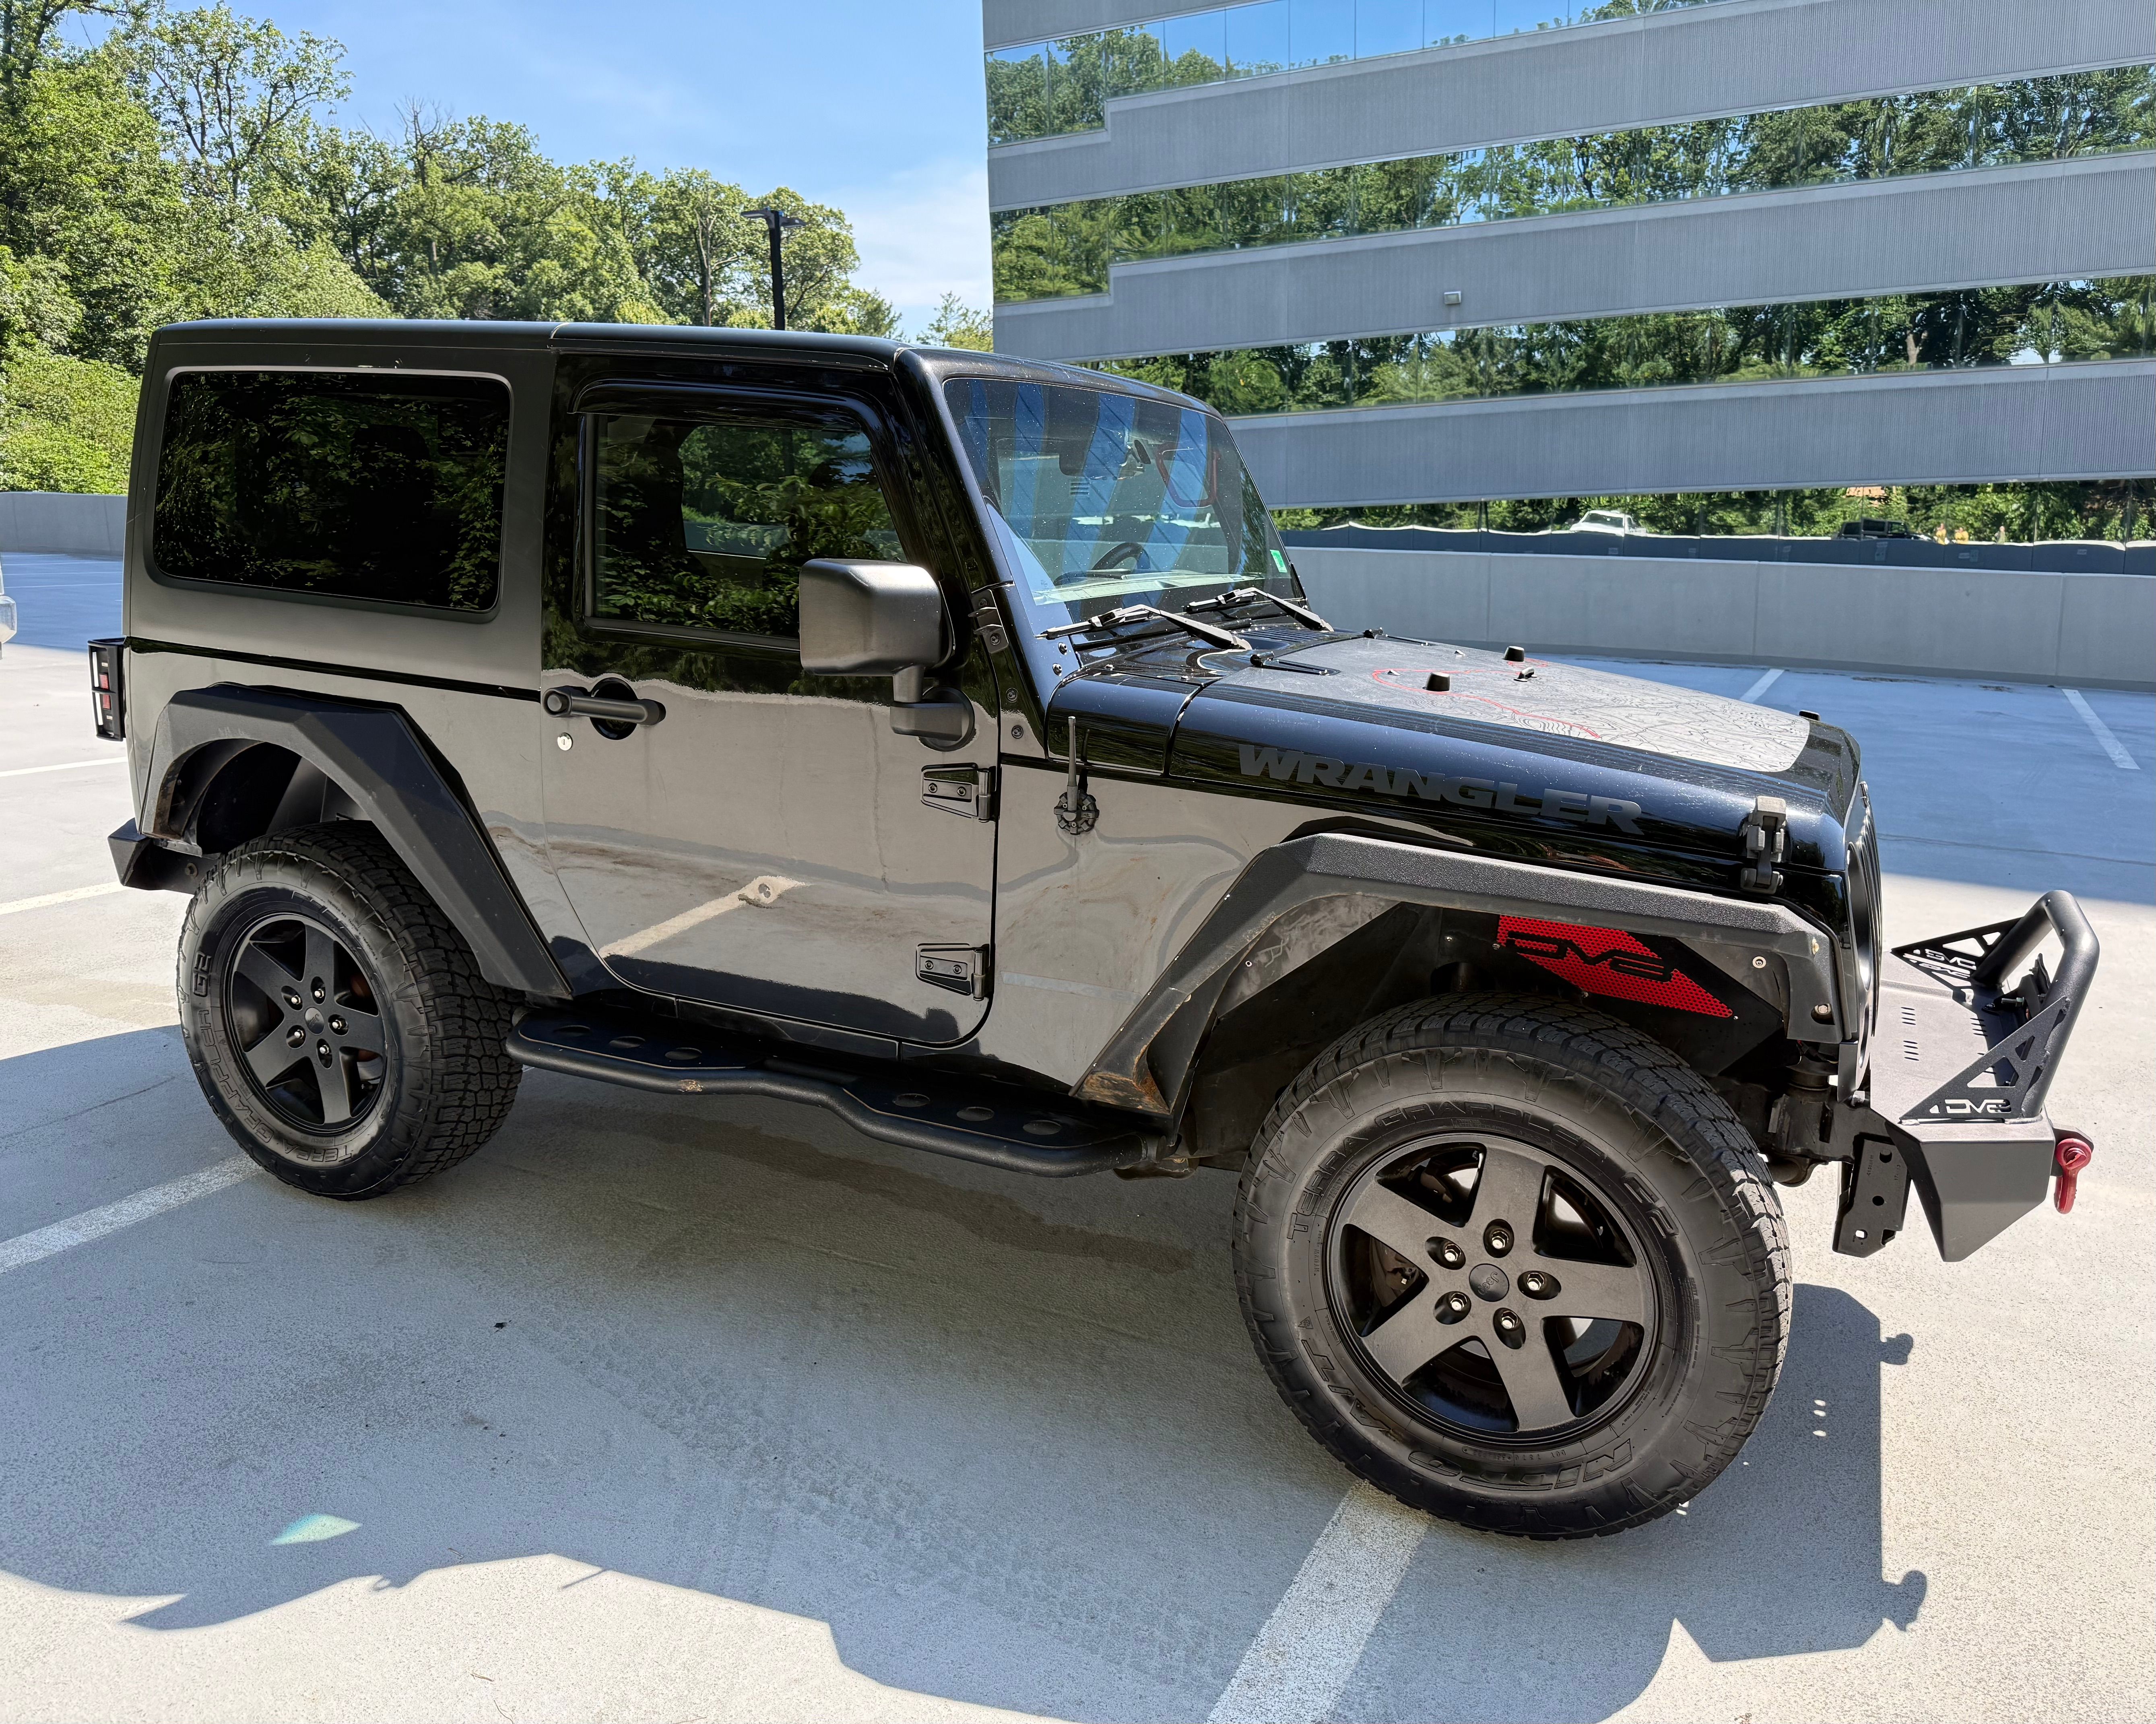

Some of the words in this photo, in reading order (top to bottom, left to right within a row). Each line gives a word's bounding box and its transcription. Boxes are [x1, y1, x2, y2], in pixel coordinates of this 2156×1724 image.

[1239, 745, 1644, 835] WRANGLER
[192, 951, 212, 997] G2
[1506, 931, 1673, 983] DV8
[199, 1009, 275, 1143] GRAPPLER
[1944, 1099, 2012, 1113] DV8
[283, 1139, 352, 1162] TERRA
[1287, 1136, 1369, 1239] TERRA
[1374, 1101, 1610, 1163] GRAPPLER
[1620, 1172, 1679, 1239] G2
[1477, 1271, 1499, 1295] Jeep
[1408, 1438, 1632, 1491] NITTO
